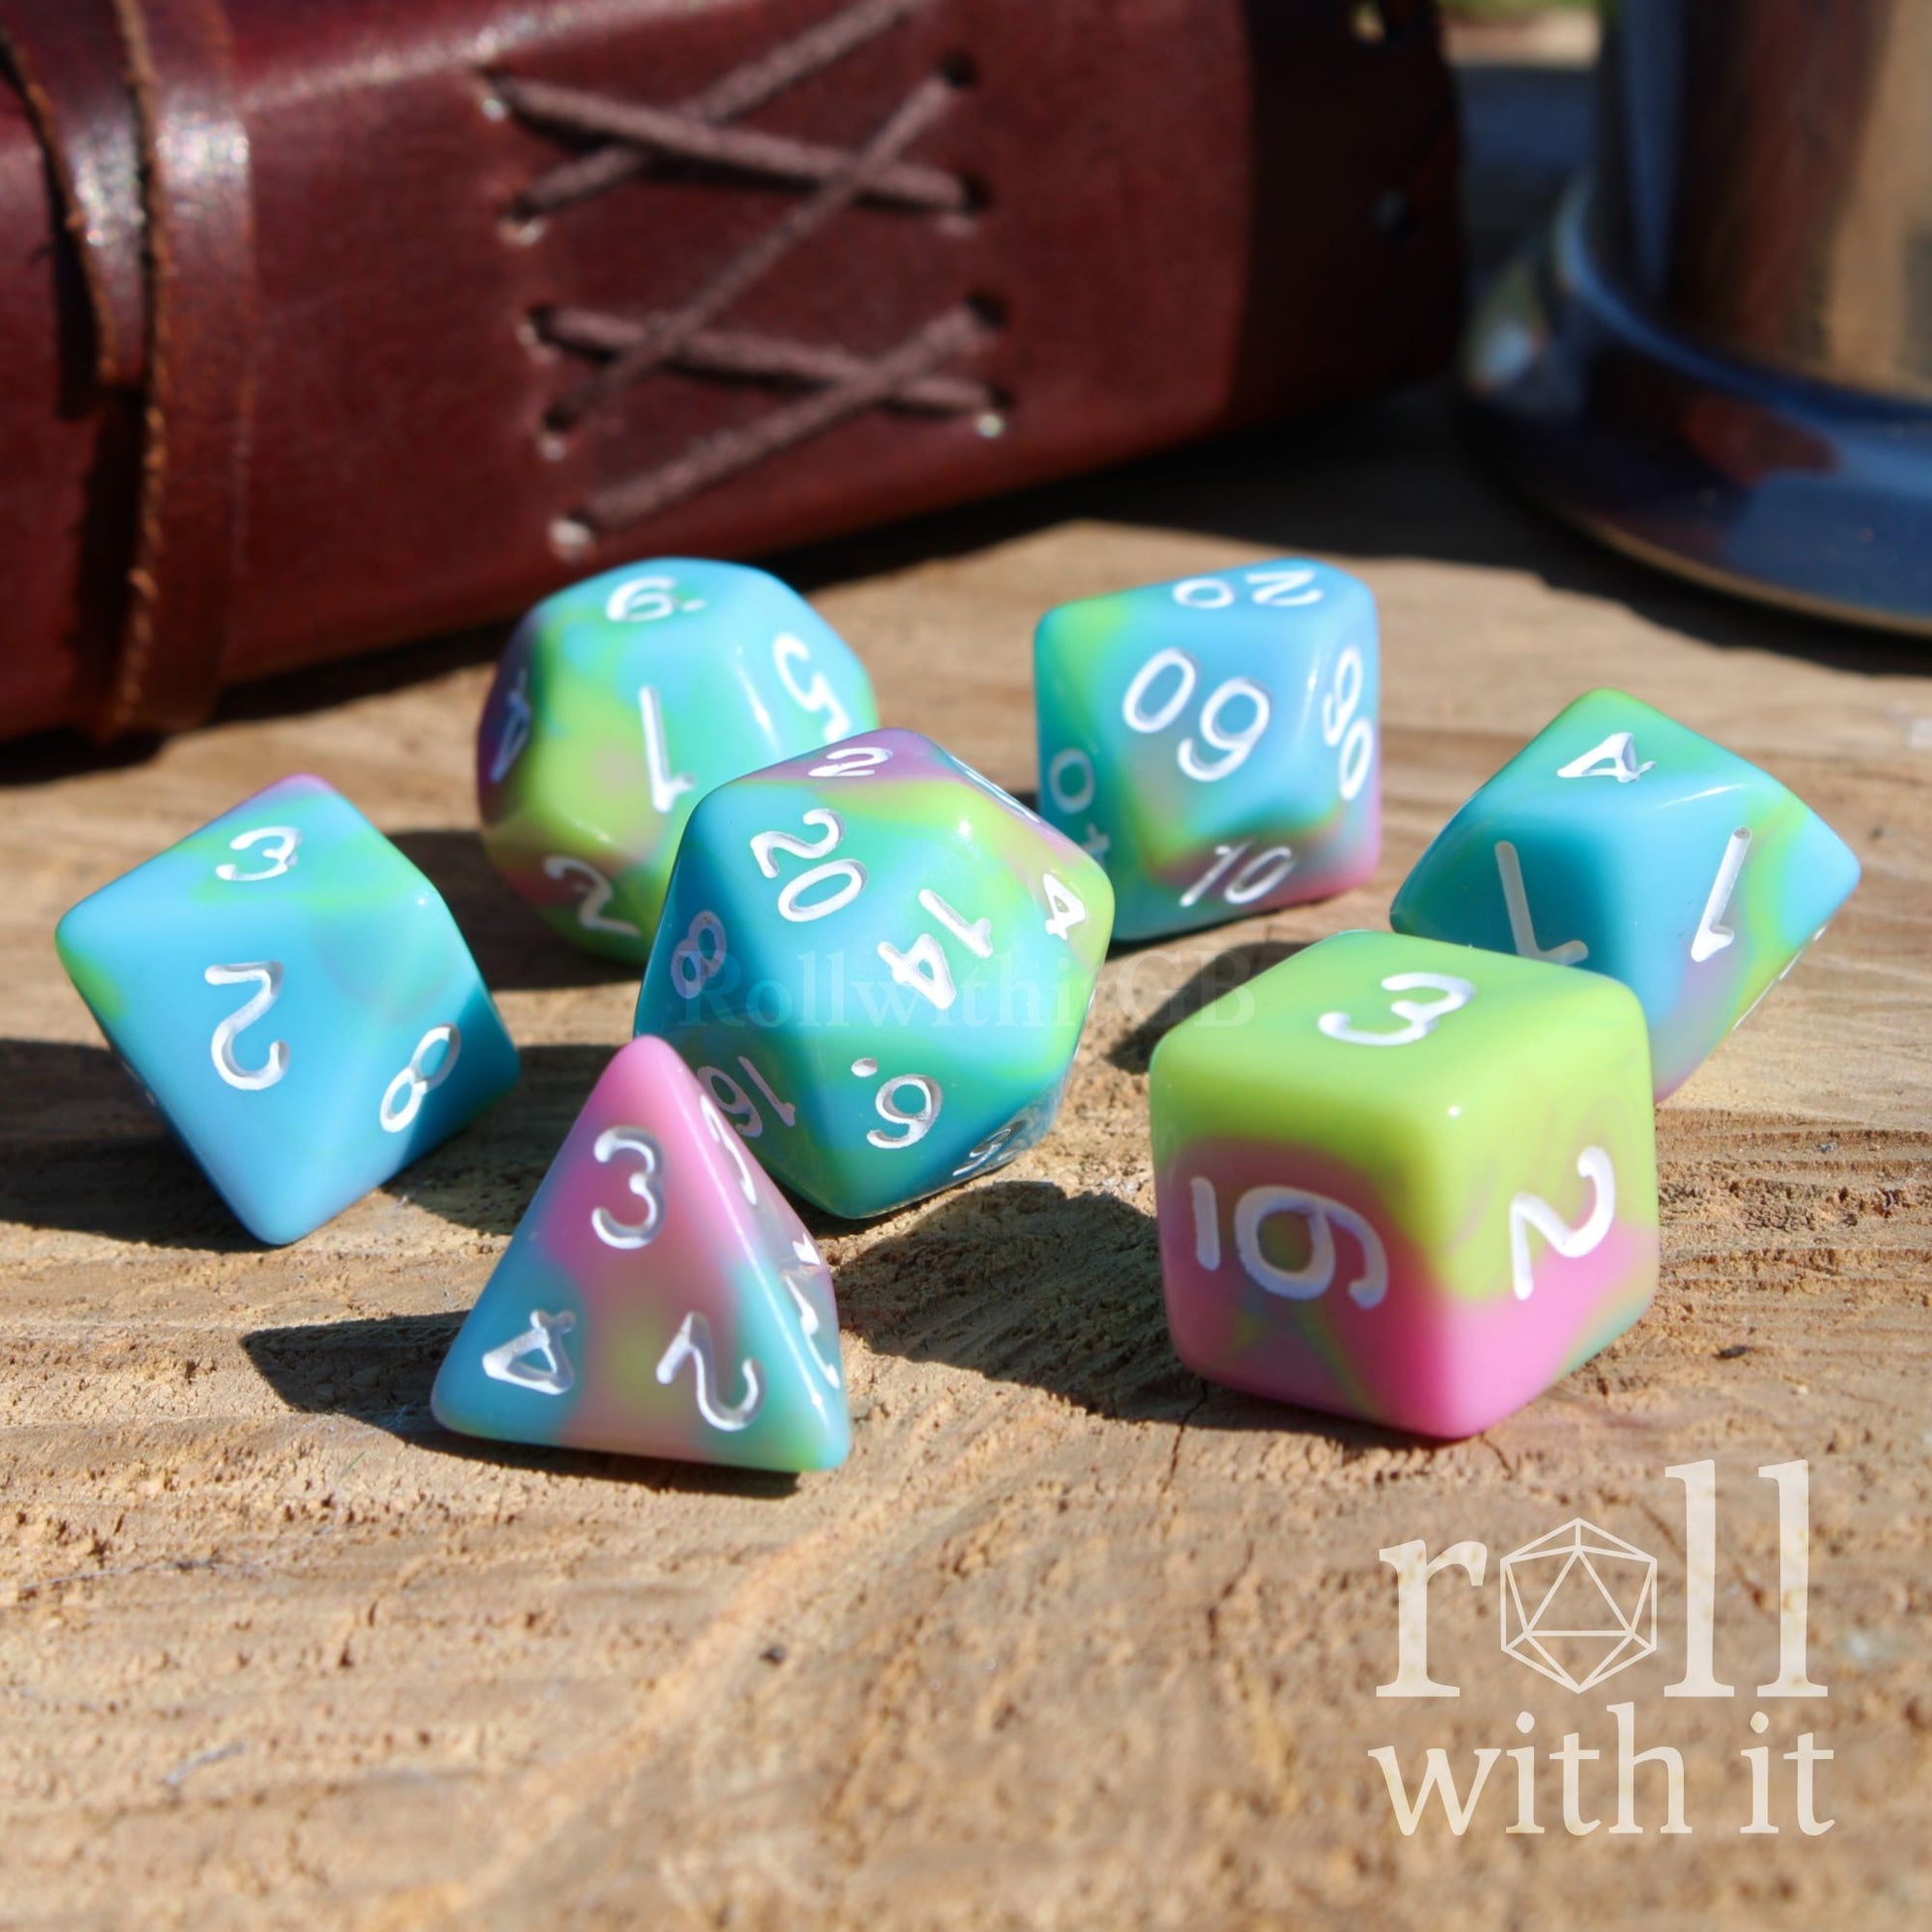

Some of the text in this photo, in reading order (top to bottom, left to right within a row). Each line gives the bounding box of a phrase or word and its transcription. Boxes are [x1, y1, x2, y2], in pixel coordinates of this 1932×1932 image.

[771, 632, 852, 744] 5
[637, 683, 696, 814] 1
[1557, 732, 1657, 783] 4
[214, 825, 303, 882] 3
[543, 853, 642, 937] 2
[751, 807, 869, 922] 20
[1042, 872, 1087, 941] 4
[1178, 838, 1296, 908] 10
[1690, 826, 1753, 963] 1
[670, 909, 728, 1000] 8
[876, 888, 994, 1011] 14
[204, 960, 285, 1091] 2
[1316, 971, 1477, 1046] 3
[378, 1022, 462, 1134] 8
[591, 1125, 666, 1250] 3
[1509, 1145, 1617, 1301] 2
[482, 1309, 577, 1396] 4
[655, 1311, 765, 1432] 2
